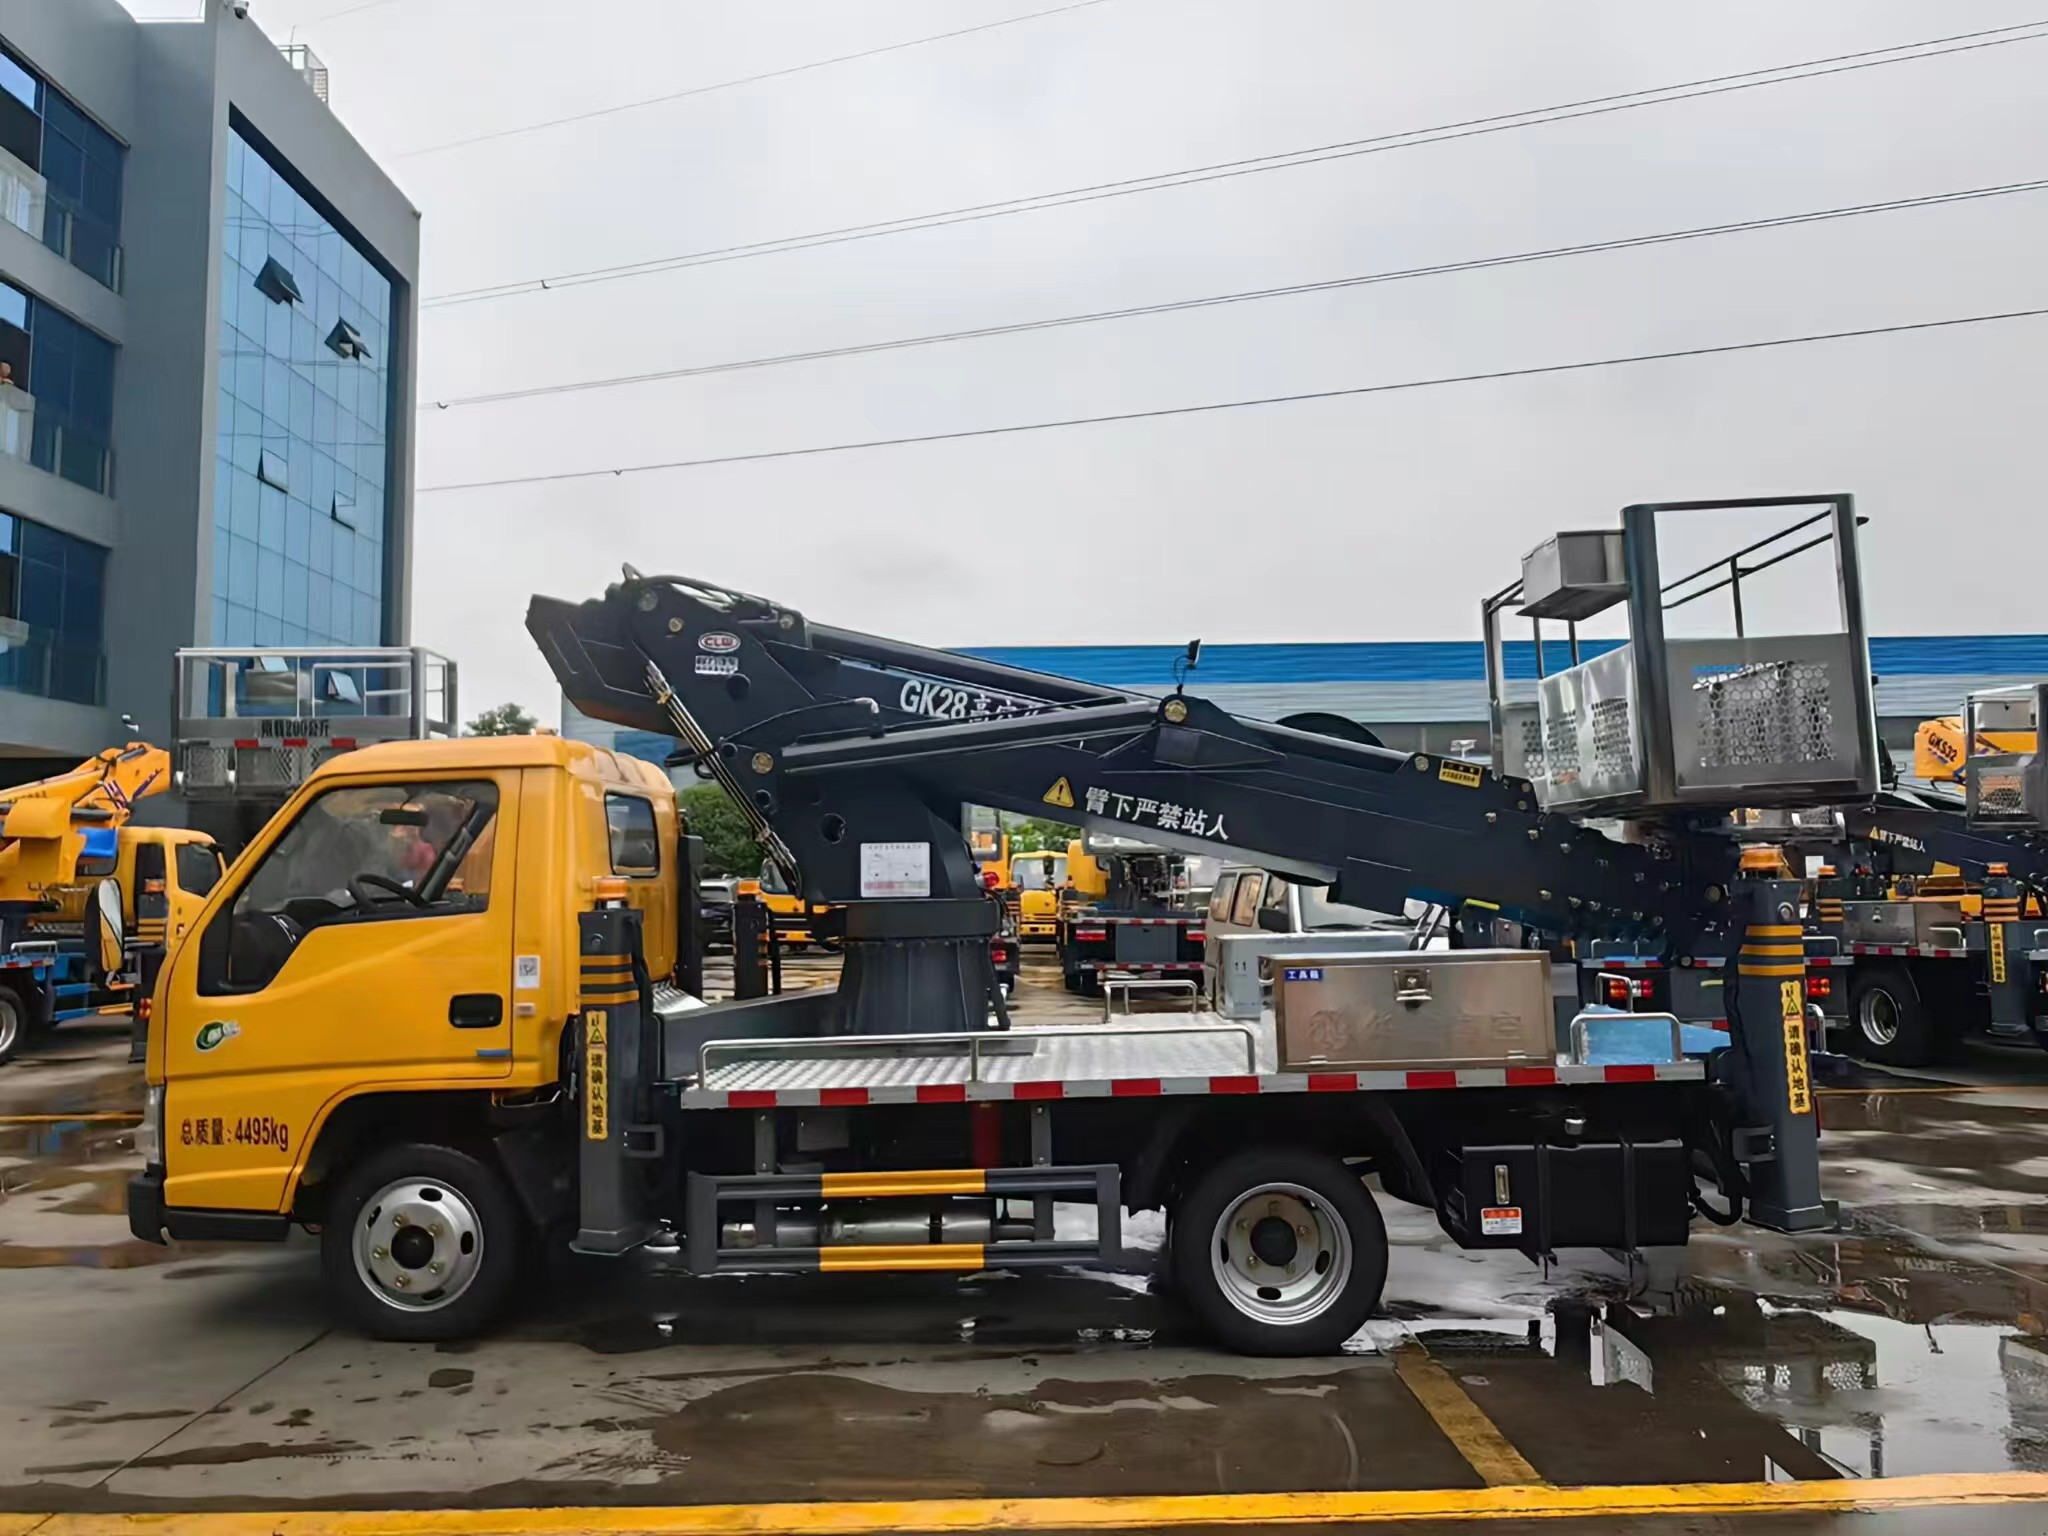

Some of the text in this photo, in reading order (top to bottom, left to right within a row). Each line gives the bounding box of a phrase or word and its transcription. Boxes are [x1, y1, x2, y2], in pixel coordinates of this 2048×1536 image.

[704, 637, 734, 647] CLW
[900, 679, 968, 720] GK28
[1085, 786, 1229, 841] 臂下严禁站人
[1788, 1024, 1805, 1108] 请确认地基
